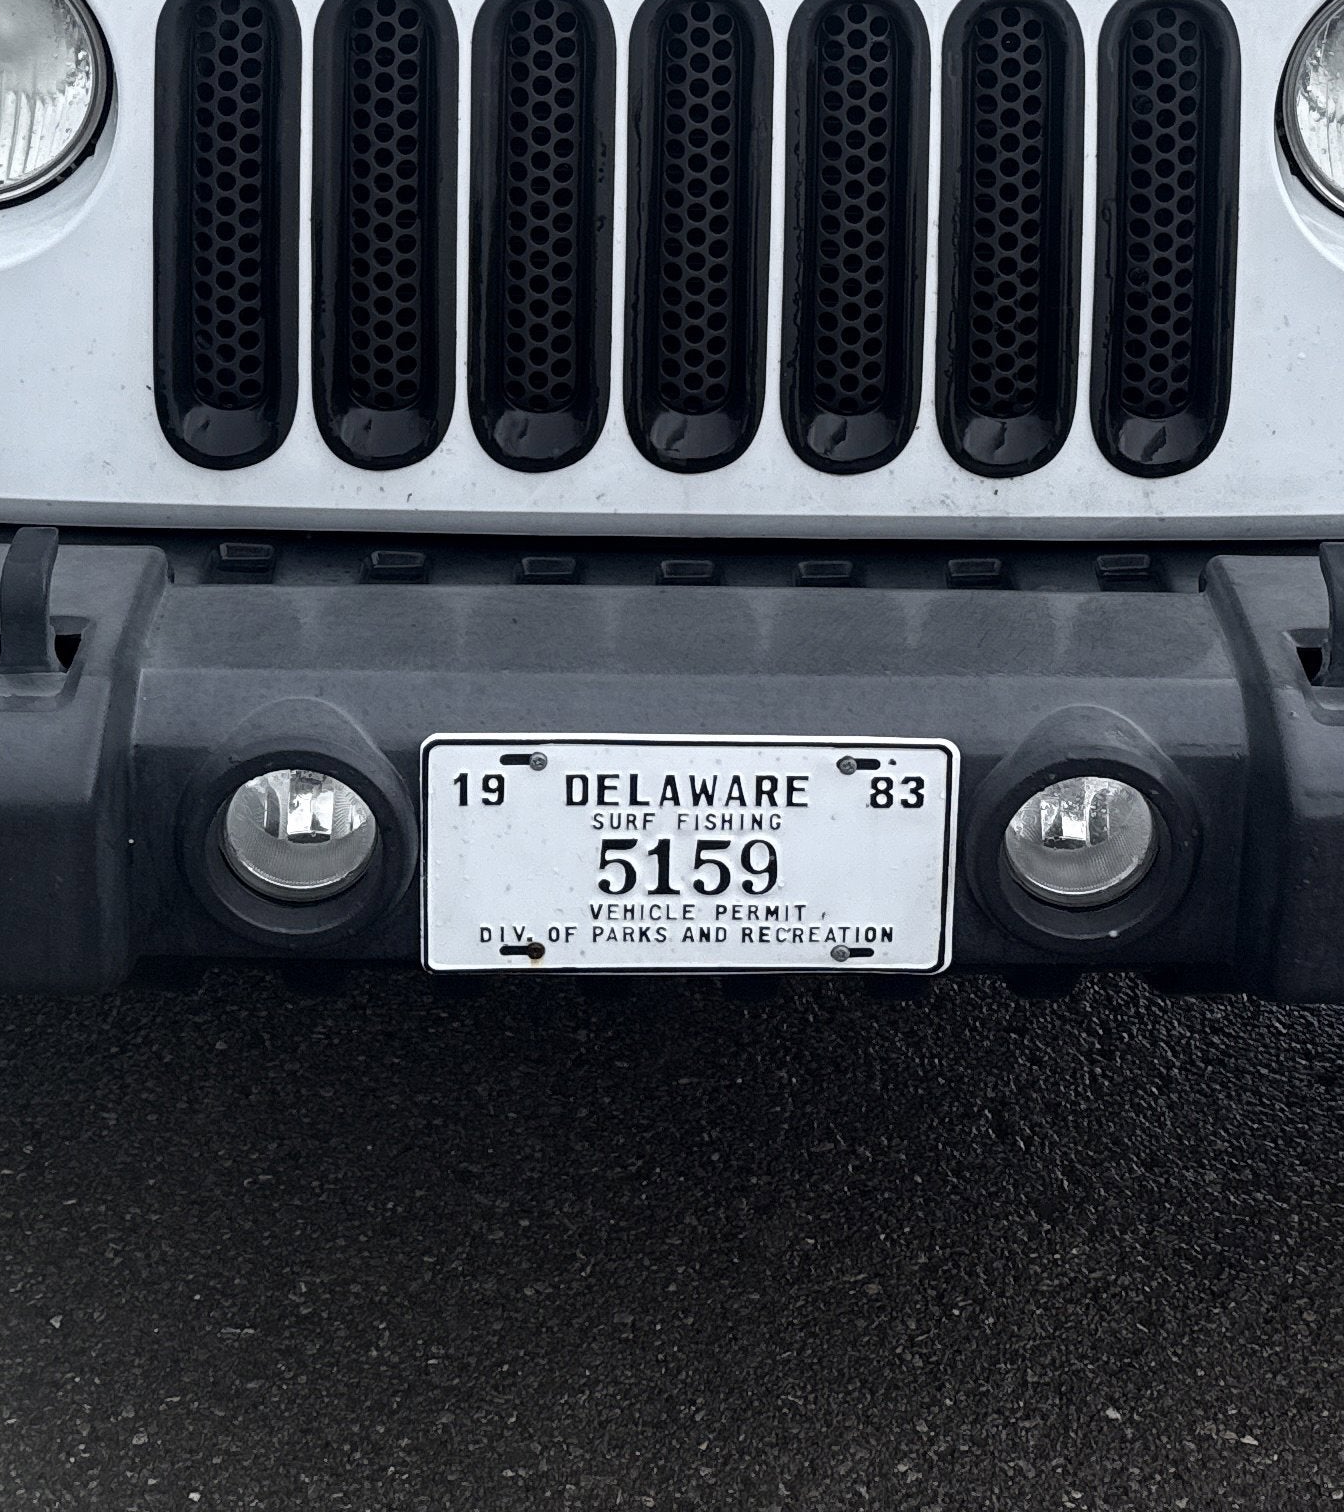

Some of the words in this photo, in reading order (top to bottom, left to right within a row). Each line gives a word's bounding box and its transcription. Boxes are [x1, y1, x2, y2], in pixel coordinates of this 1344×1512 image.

[453, 772, 506, 807] 19
[565, 773, 810, 808] DELAWARE
[868, 775, 926, 809] 83
[592, 812, 656, 831] SURF
[677, 812, 783, 831] FISHING
[597, 838, 779, 896] 5159
[589, 903, 696, 921] VEHICLE
[715, 904, 807, 921] PERMIT
[480, 926, 533, 944] DIV.
[548, 926, 577, 943] OF
[592, 926, 667, 943] PARKS
[682, 926, 728, 943] AND
[741, 926, 895, 943] RECREATION
